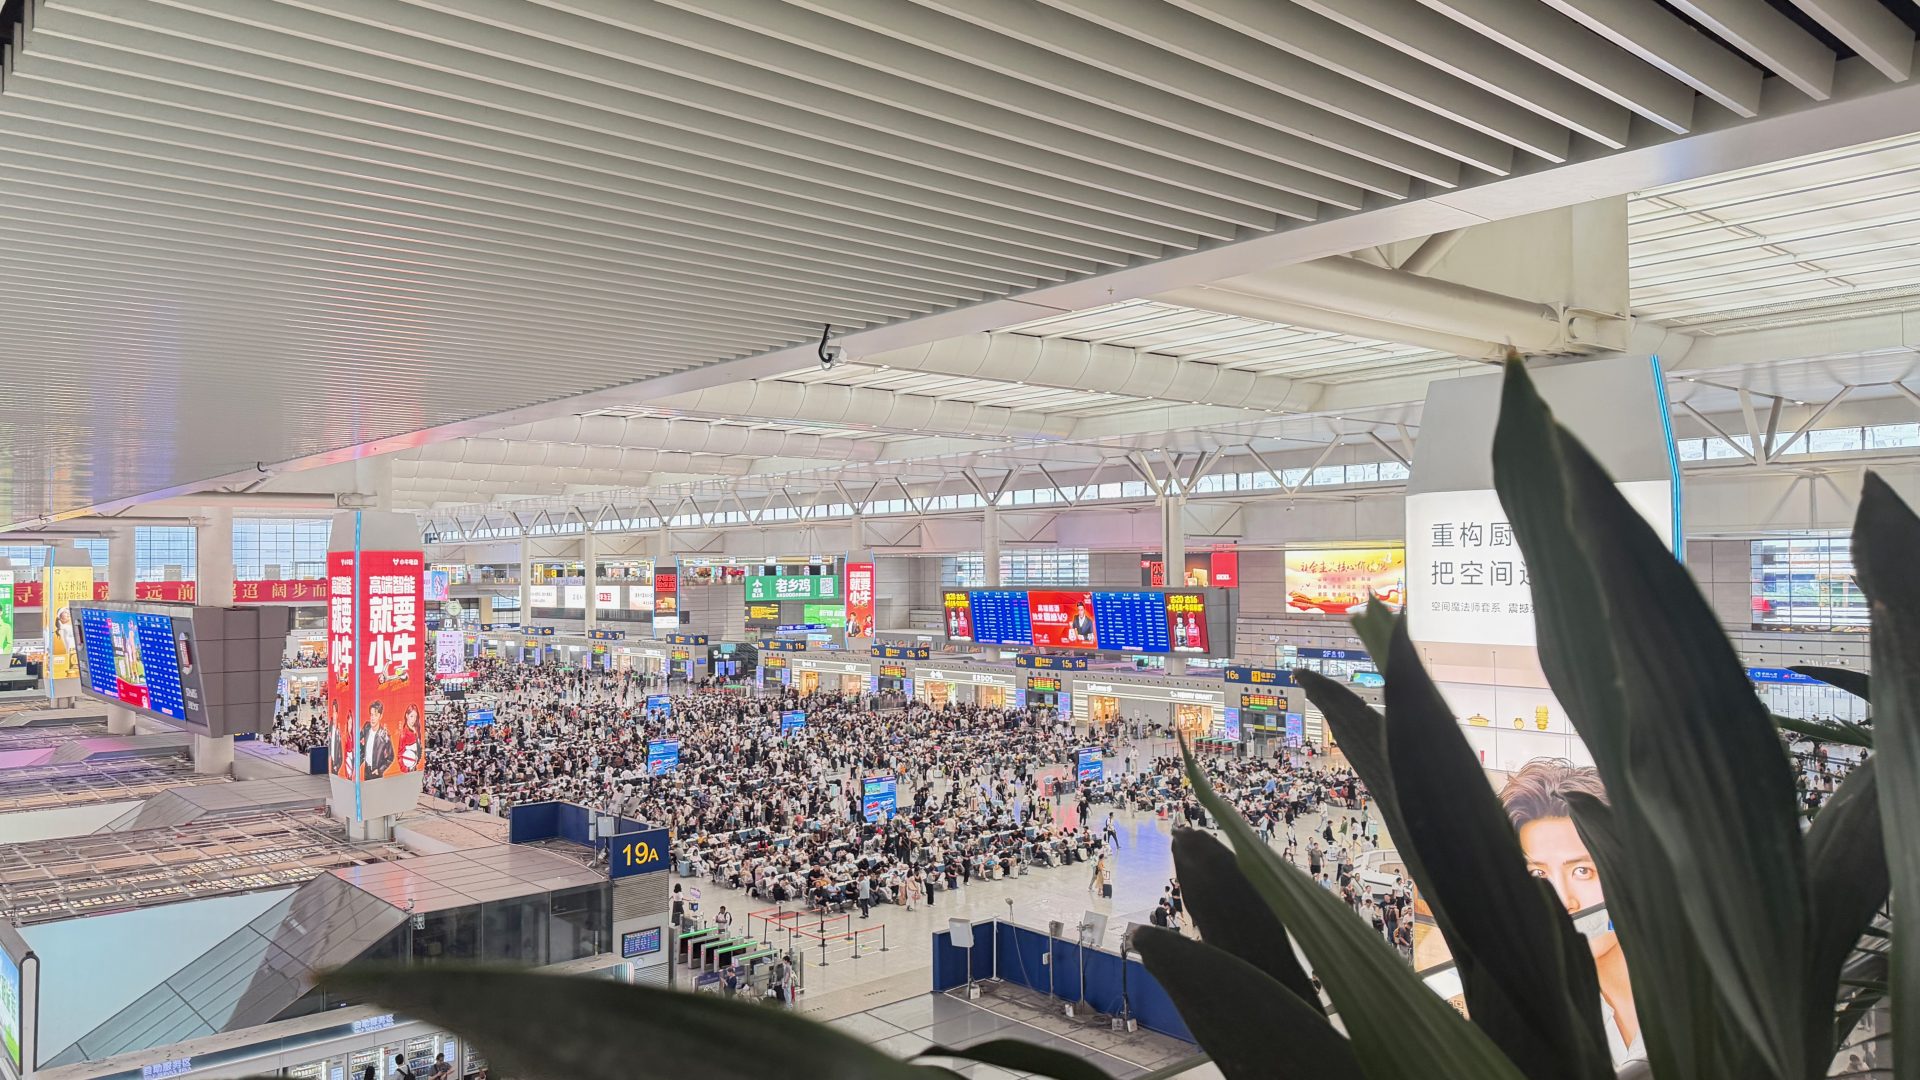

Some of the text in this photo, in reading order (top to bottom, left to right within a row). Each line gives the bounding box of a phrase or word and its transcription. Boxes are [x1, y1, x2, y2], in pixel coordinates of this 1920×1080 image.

[1431, 521, 1513, 548] 重构厨
[368, 575, 416, 595] 高端智能
[775, 578, 811, 592] 老乡鸡
[1431, 560, 1531, 587] 把空间
[368, 596, 416, 634] 就要
[1431, 601, 1502, 613] 空间魔法师套系
[368, 633, 417, 674] 小牛
[622, 841, 659, 866] 19A
